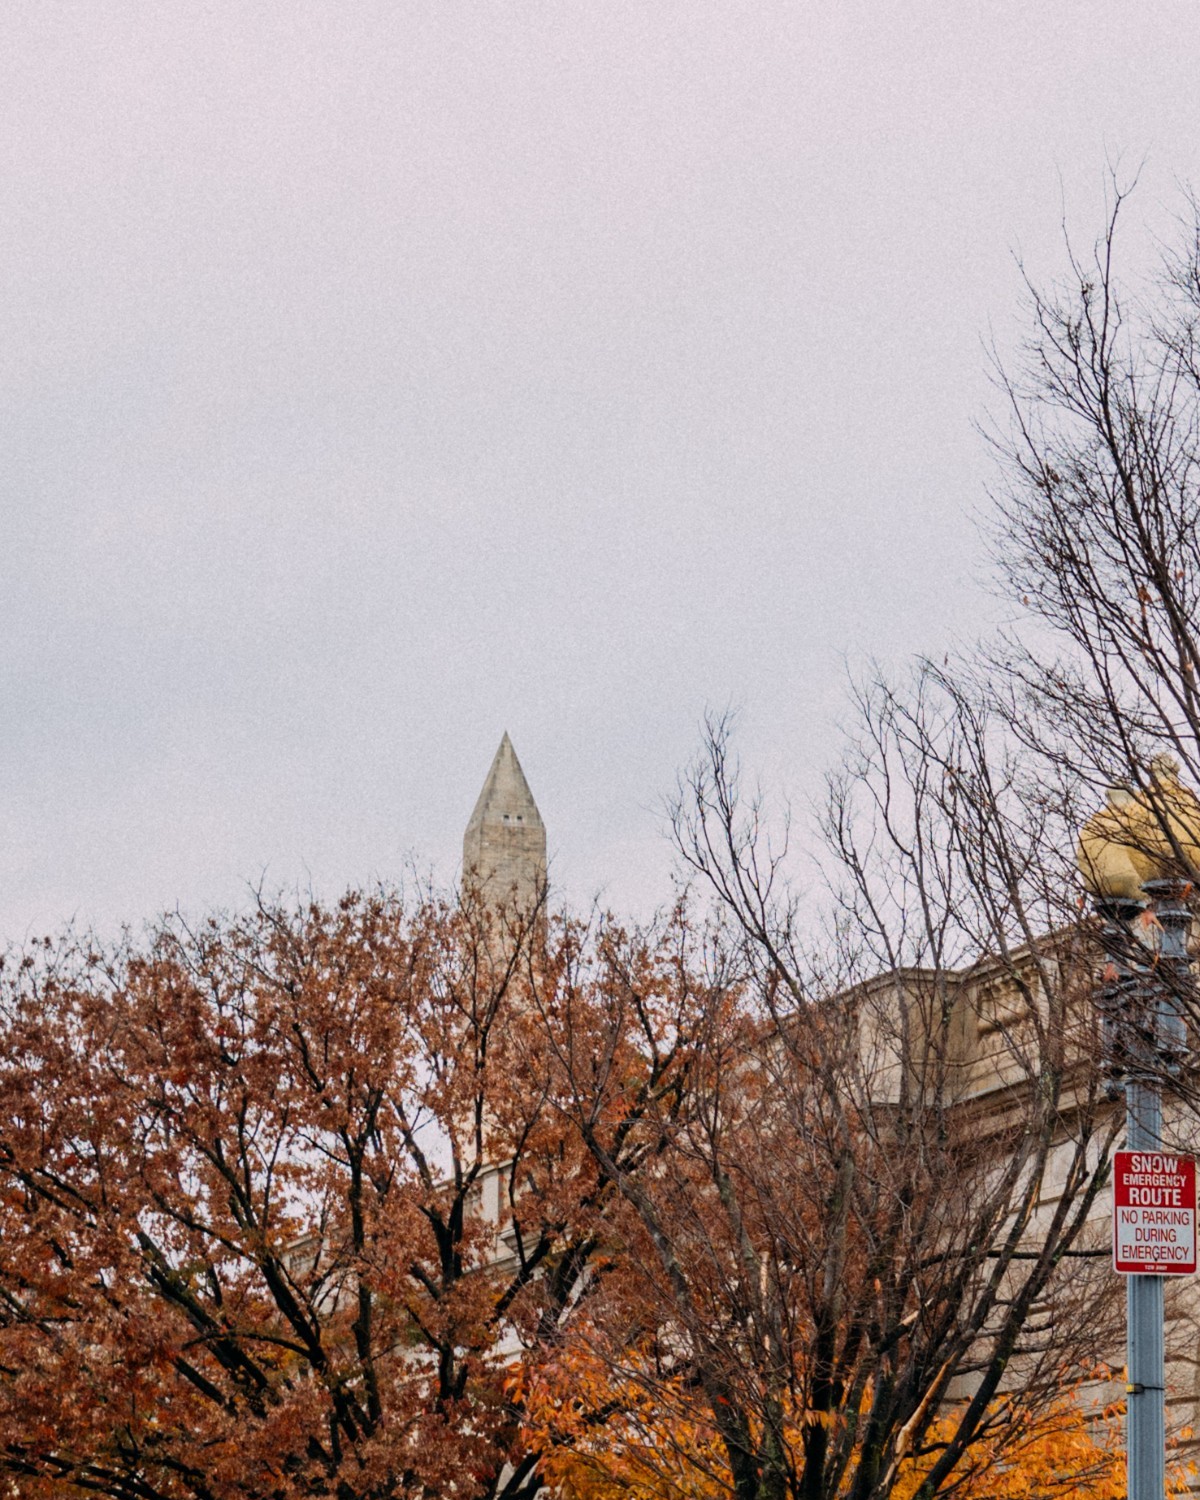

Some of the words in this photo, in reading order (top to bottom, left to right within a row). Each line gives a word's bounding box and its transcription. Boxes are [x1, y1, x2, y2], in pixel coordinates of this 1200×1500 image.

[1131, 1155, 1178, 1174] SNOW
[1123, 1173, 1187, 1187] EMERGENCY
[1129, 1187, 1182, 1206] ROUTE
[1121, 1210, 1138, 1224] NO
[1142, 1210, 1190, 1226] PARKING
[1135, 1228, 1177, 1243] DURING
[1122, 1245, 1189, 1260] EMERGENCY
